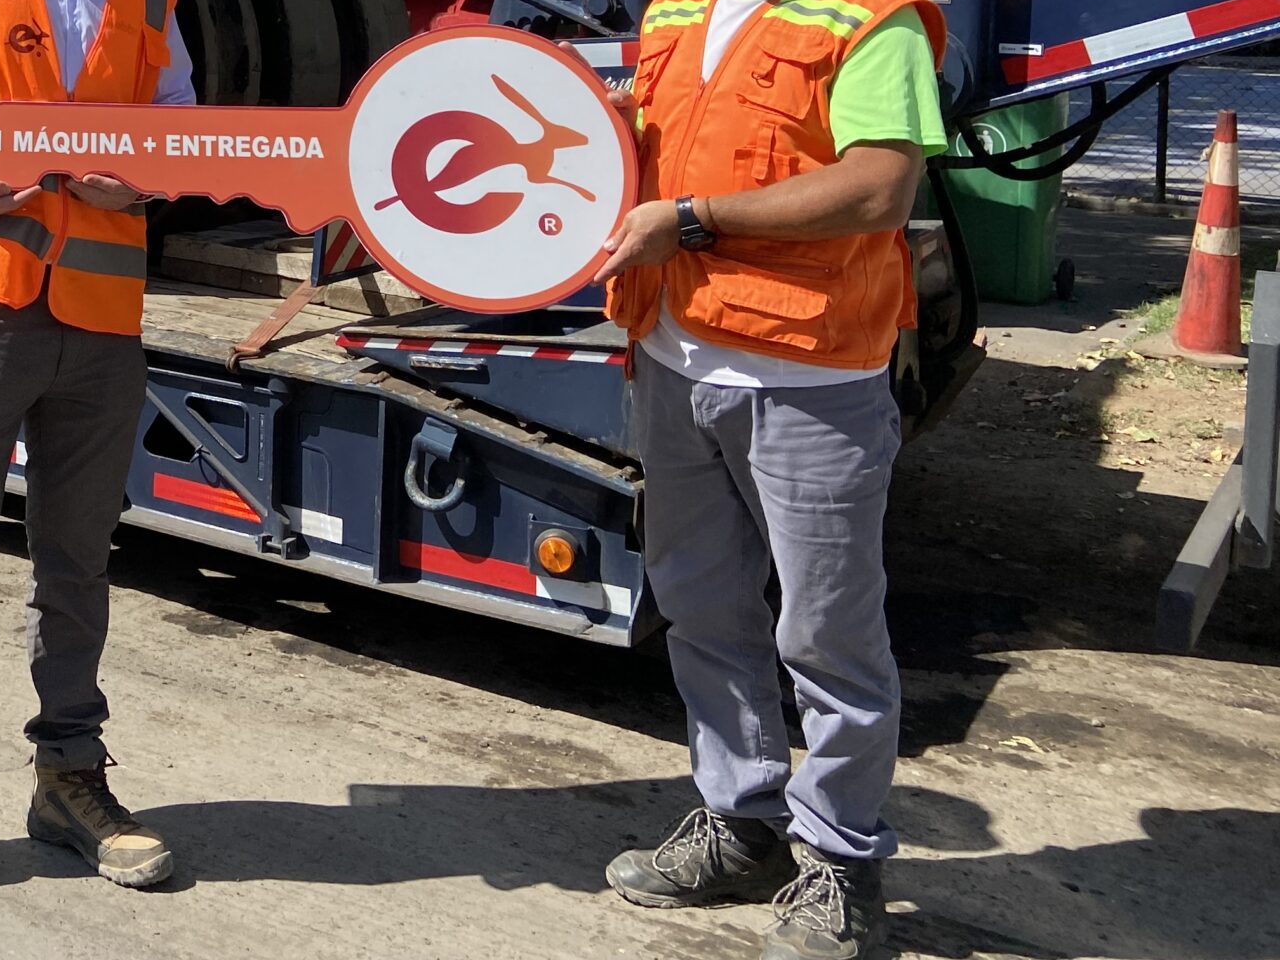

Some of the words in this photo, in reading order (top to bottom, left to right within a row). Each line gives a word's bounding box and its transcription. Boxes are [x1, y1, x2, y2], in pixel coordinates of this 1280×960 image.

[13, 126, 135, 155] MÁQUINA
[143, 139, 157, 153] +
[166, 134, 325, 159] ENTREGADA
